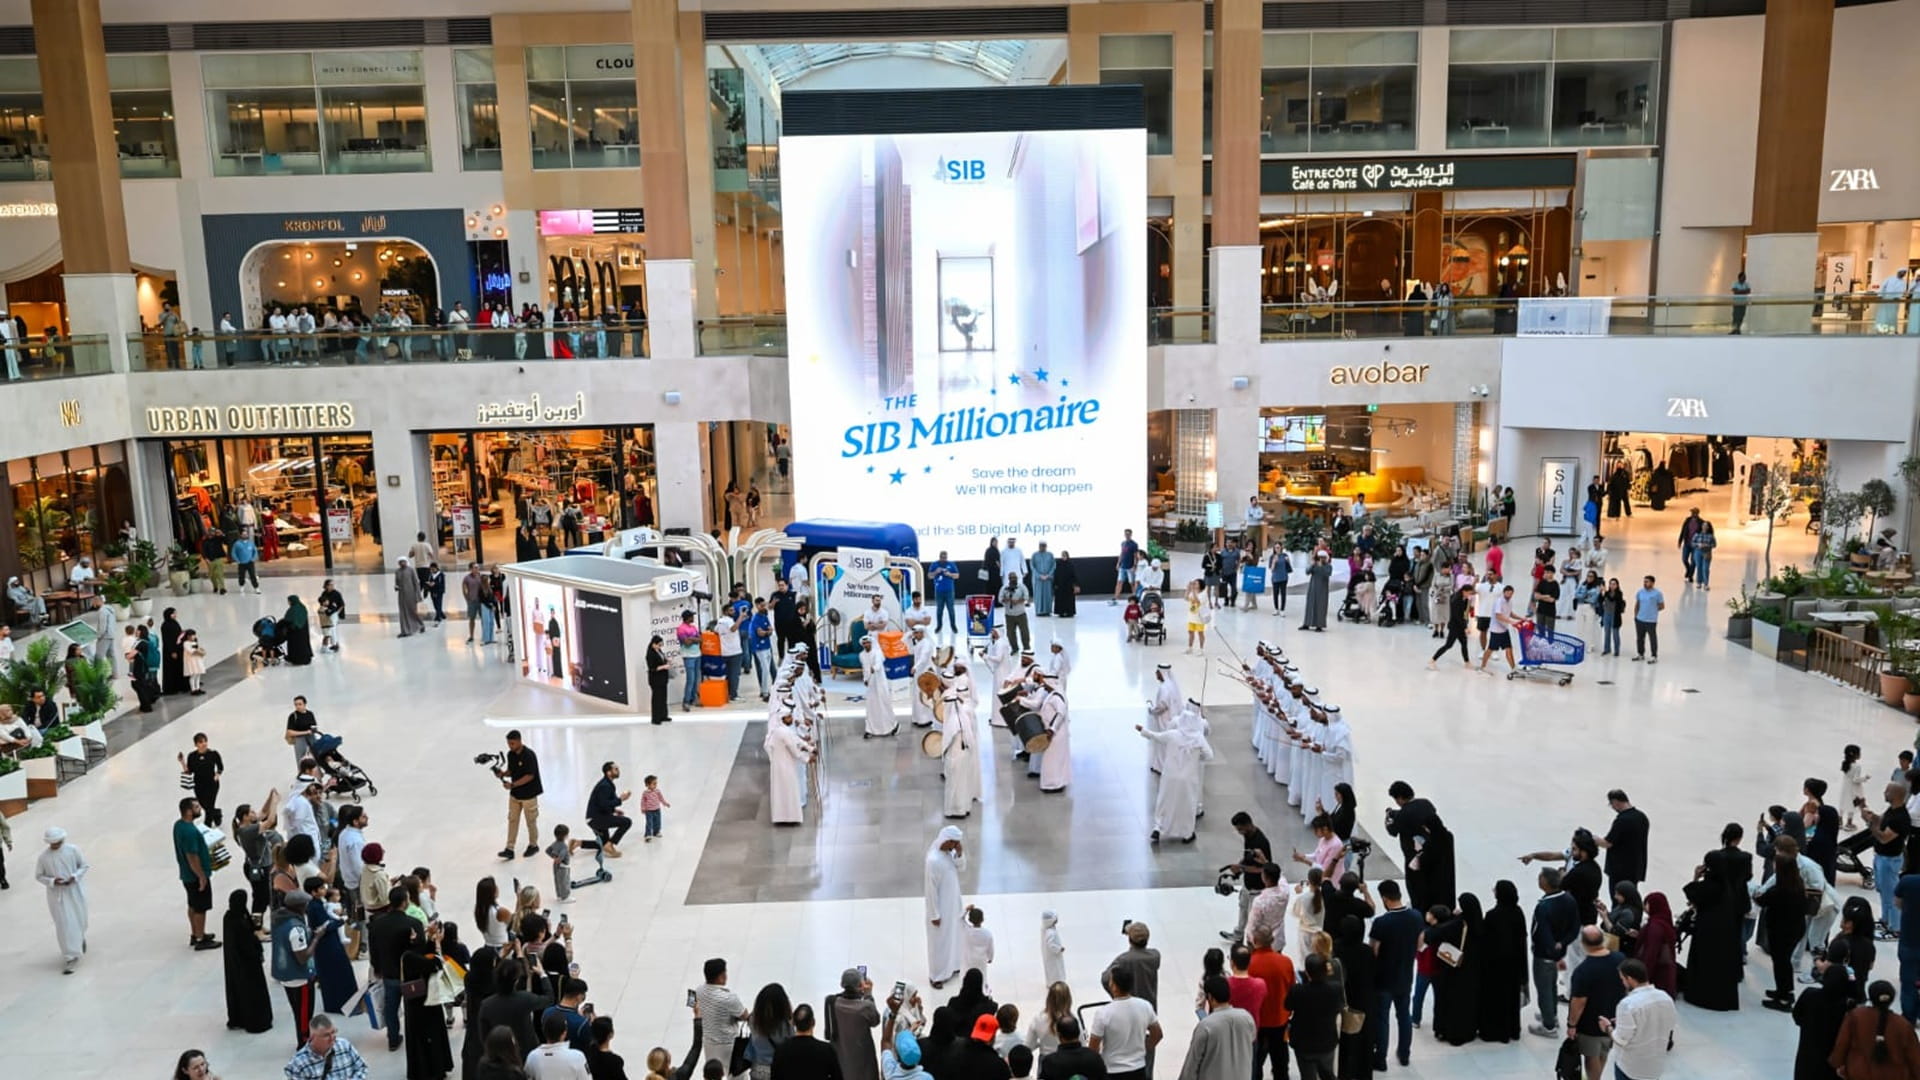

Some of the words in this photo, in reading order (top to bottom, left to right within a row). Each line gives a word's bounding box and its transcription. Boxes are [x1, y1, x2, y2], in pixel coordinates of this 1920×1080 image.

[596, 58, 634, 69] CLOU
[947, 160, 986, 180] SIB
[1292, 179, 1315, 190] Café
[1316, 179, 1330, 189] de
[1332, 179, 1357, 189] Paris
[1829, 168, 1880, 192] ZARA
[284, 219, 345, 233] KRONFOL
[1330, 360, 1430, 385] avobar
[543, 392, 583, 421] أوربن
[884, 394, 918, 410] THE
[1667, 397, 1708, 418] ZARA
[147, 406, 218, 432] URBAN
[226, 404, 353, 430] OUTFITTERS
[841, 421, 901, 457] SIB
[907, 395, 1100, 449] Millionaire
[971, 467, 1004, 479] Save
[1007, 466, 1029, 478] the
[1031, 466, 1076, 477] dream
[955, 484, 986, 496] We'll
[989, 483, 1027, 495] make
[1030, 482, 1038, 494] it
[1041, 482, 1093, 496] happen
[1552, 469, 1566, 523] SALE
[933, 525, 954, 536] the
[957, 524, 977, 535] SIB
[979, 523, 1021, 538] Digital
[1024, 522, 1051, 535] App
[1053, 522, 1081, 532] now
[633, 533, 647, 545] SIB
[854, 557, 873, 569] SIB
[669, 580, 689, 594] SIB
